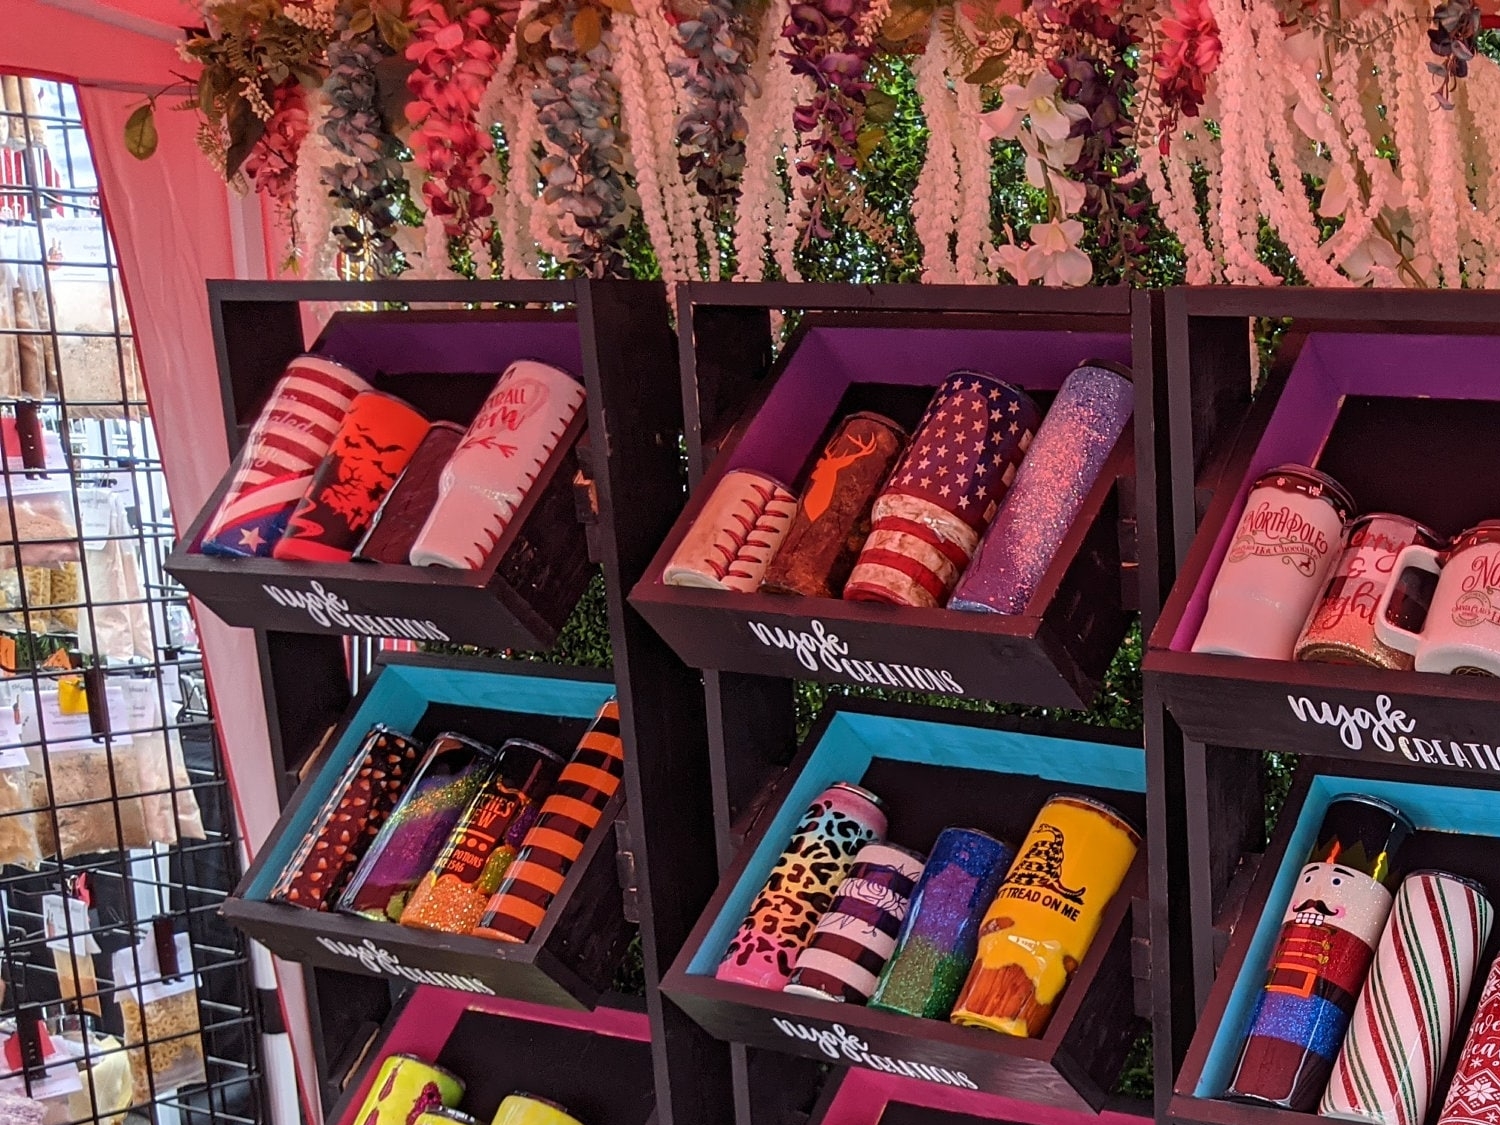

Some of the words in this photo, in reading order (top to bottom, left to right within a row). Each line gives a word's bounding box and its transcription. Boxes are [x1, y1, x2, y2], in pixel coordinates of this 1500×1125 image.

[1237, 502, 1290, 540] NORTH
[1286, 512, 1329, 555] POLE
[1351, 531, 1406, 573] erry
[748, 619, 848, 672] nygk
[841, 657, 965, 694] CREATIONS
[1288, 695, 1416, 751] nygk
[1006, 887, 1042, 903] TREAD
[1041, 895, 1062, 912] ON
[1061, 903, 1081, 922] ME
